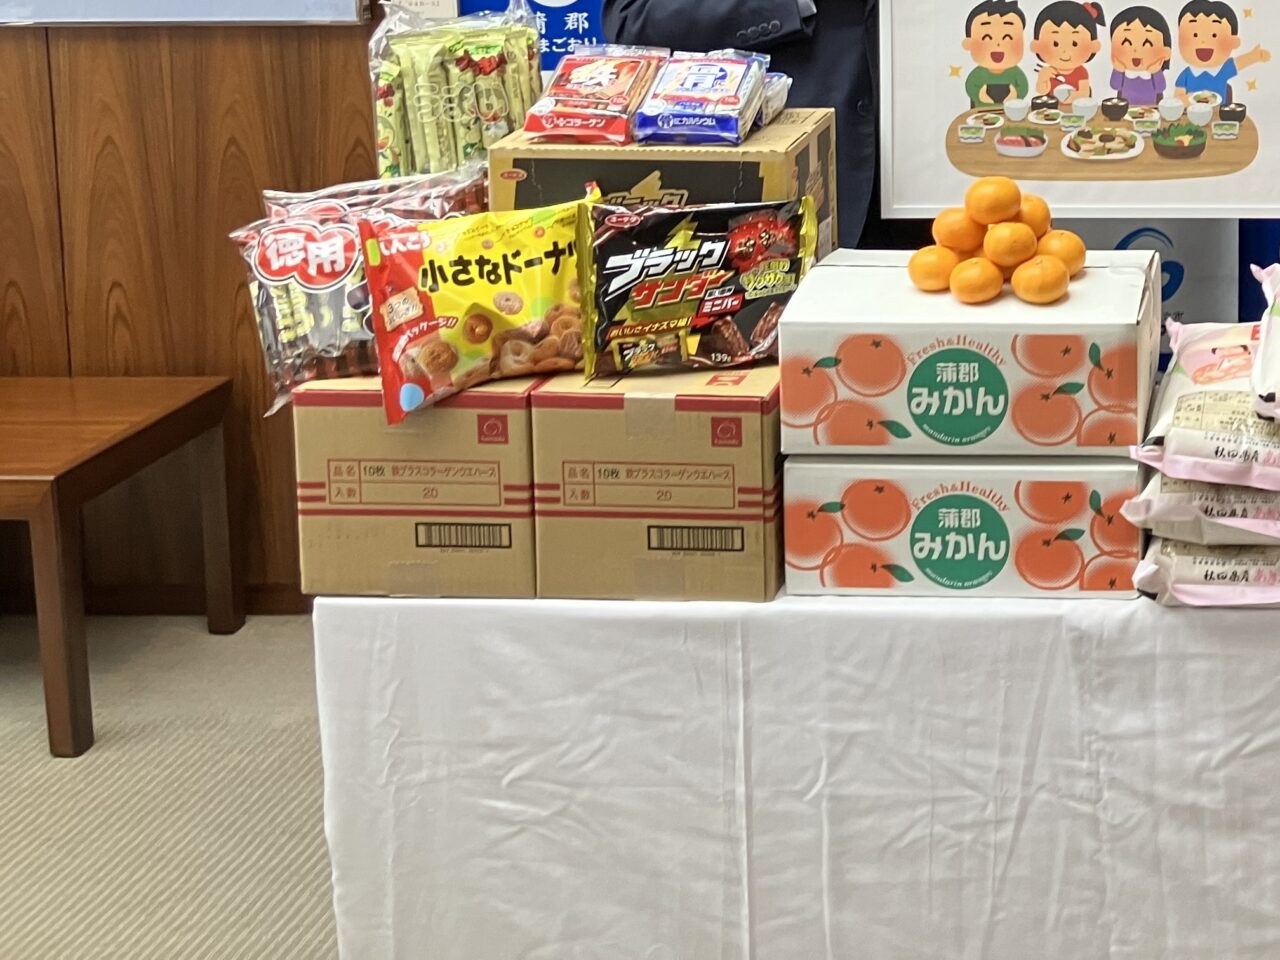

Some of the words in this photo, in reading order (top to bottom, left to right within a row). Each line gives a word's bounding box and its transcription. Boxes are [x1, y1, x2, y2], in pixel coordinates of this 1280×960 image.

[264, 232, 346, 276] 徳用
[606, 240, 729, 295] ブラック
[630, 270, 733, 309] サンダー
[702, 298, 740, 313] ミニバー
[906, 335, 1006, 366] Fresh&Healthy
[936, 362, 979, 383] 蒲郡
[910, 386, 1006, 416] みかん
[422, 488, 438, 499] 20
[656, 490, 672, 502] 20
[912, 481, 1009, 511] Fresh&Healthy
[938, 508, 981, 529] 蒲郡
[913, 531, 1007, 561] みかん
